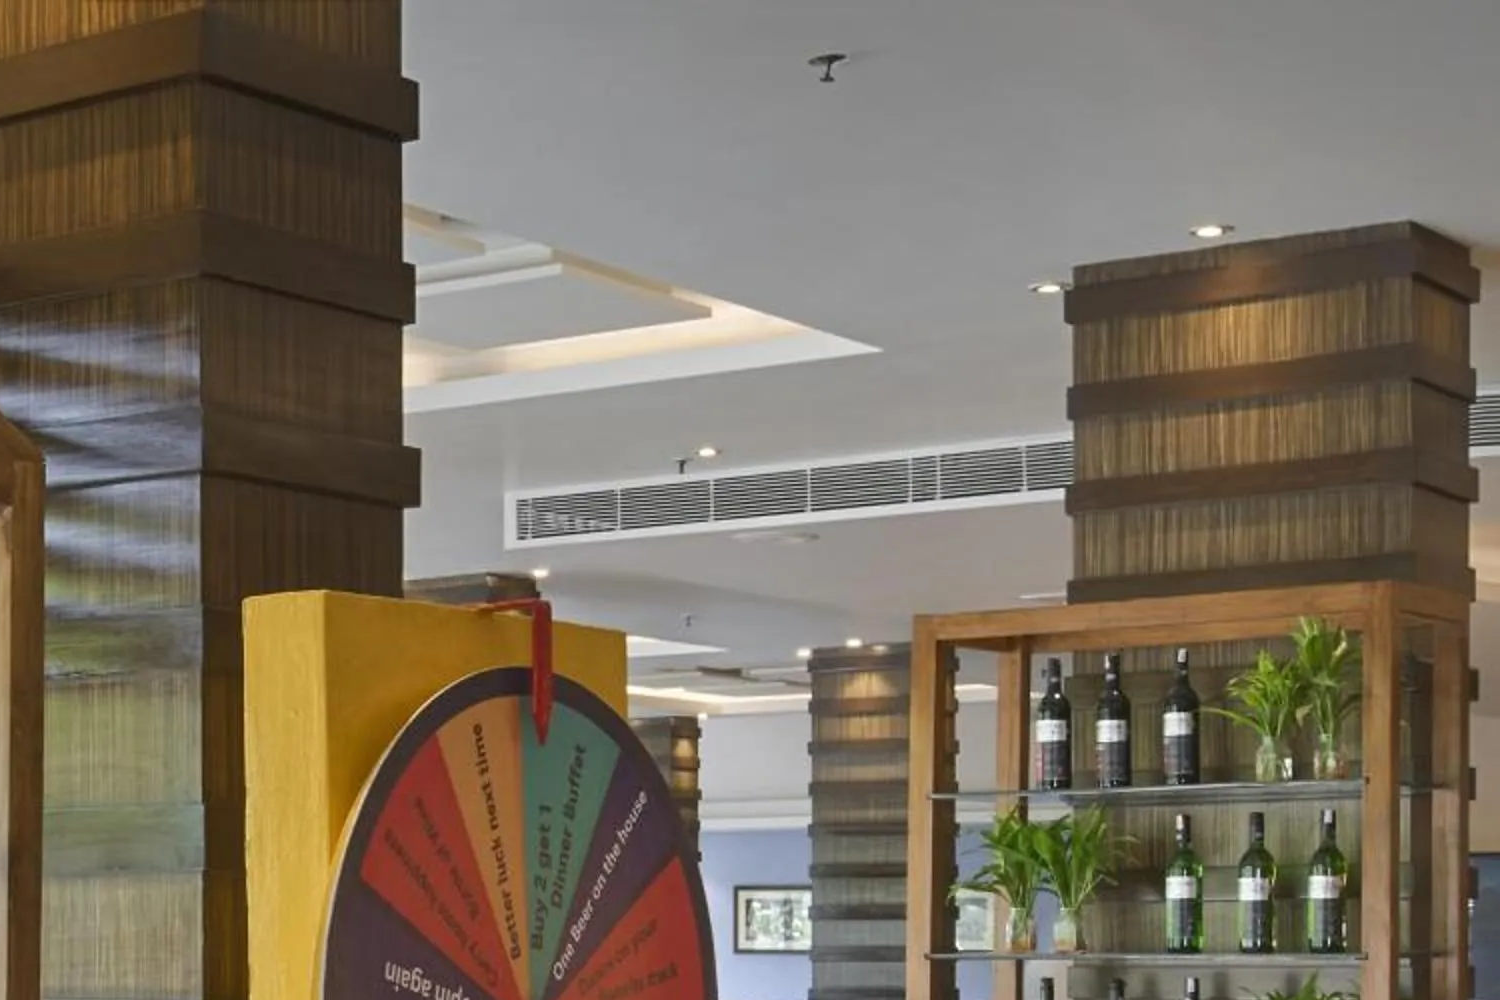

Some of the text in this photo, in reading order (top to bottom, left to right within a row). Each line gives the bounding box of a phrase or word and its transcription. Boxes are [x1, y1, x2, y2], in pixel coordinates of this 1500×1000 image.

[472, 722, 522, 961] Better luck next time
[538, 823, 552, 868] get
[551, 744, 587, 910] Dinner Buffet
[534, 875, 547, 892] 2
[553, 791, 648, 981] One Beer on the house
[531, 898, 549, 951] Buy
[385, 961, 433, 998] again
